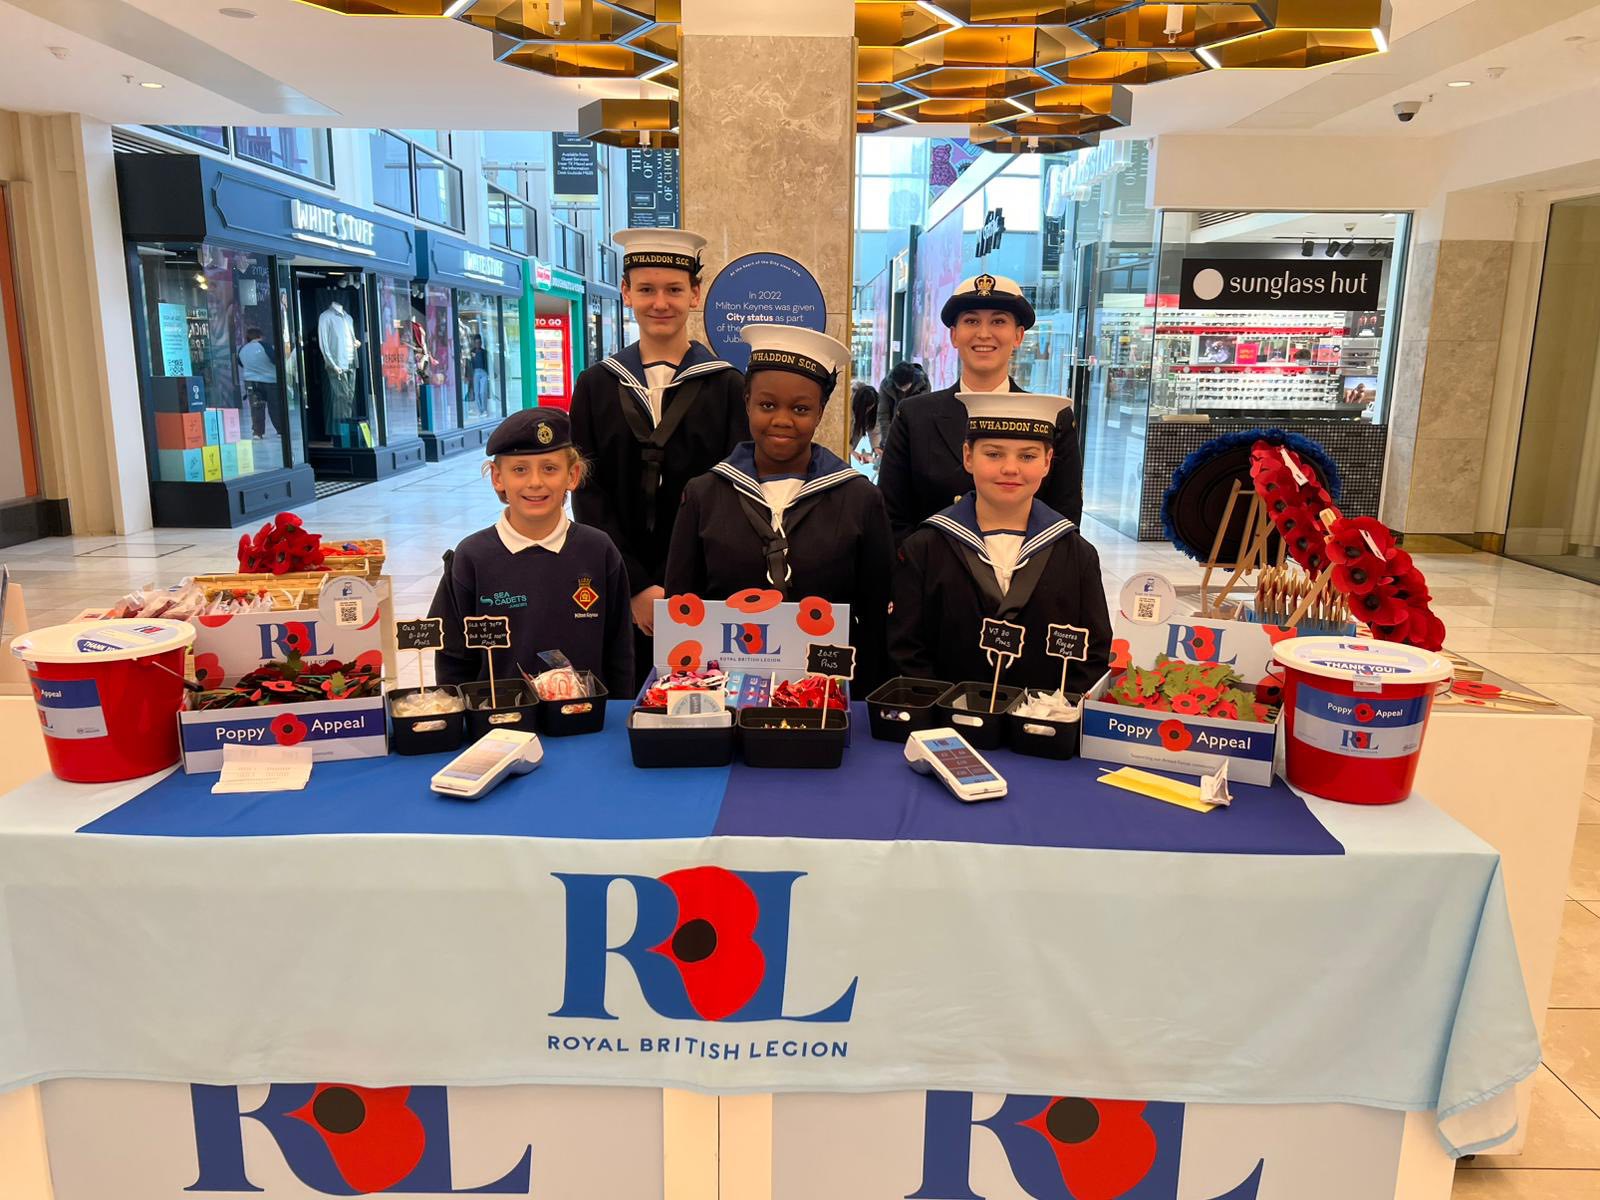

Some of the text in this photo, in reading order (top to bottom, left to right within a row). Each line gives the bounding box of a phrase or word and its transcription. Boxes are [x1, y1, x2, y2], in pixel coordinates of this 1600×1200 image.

[664, 149, 673, 183] CHOIC
[291, 199, 374, 246] WHITE STUFF
[632, 254, 673, 264] WHADDON
[1229, 270, 1368, 300] sunglass hut
[748, 291, 782, 300] In 2022
[715, 302, 742, 311] Milton
[743, 302, 773, 313] Keynes
[792, 303, 815, 314] given
[535, 318, 562, 326] TO GO
[726, 313, 745, 323] City
[746, 313, 774, 322] status
[786, 315, 804, 323] part
[716, 323, 726, 332] of
[752, 352, 796, 364] WHADDON
[979, 420, 1030, 432] WHADDON
[493, 591, 510, 600] SEA
[494, 594, 528, 606] CADETS
[816, 650, 840, 658] 2025
[1324, 661, 1396, 674] THANK YOU!
[41, 689, 62, 699] Appeal
[1327, 702, 1403, 718] Poppy Appeal
[216, 716, 365, 742] Poppy Appeal
[1109, 718, 1251, 750] Poppy Appeal
[547, 1035, 849, 1060] ROYAL BRITISH LEGION
